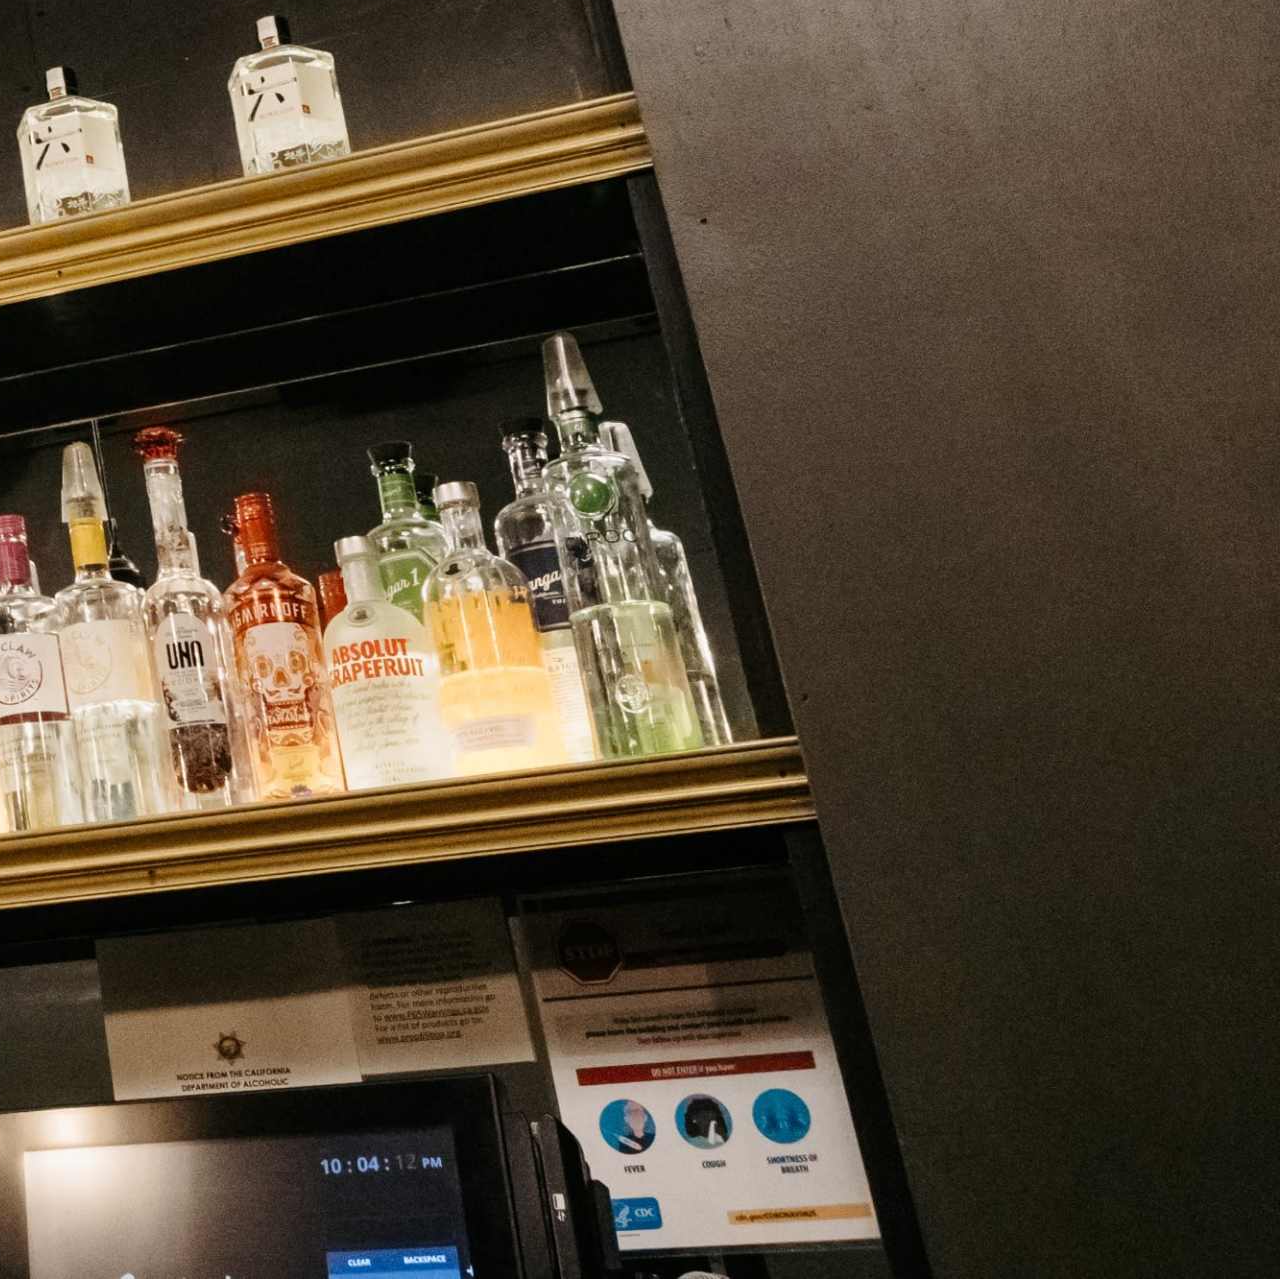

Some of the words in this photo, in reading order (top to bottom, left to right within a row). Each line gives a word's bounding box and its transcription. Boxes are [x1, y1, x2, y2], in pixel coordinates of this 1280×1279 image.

[585, 528, 638, 544] ROC
[387, 577, 411, 605] gar
[235, 601, 307, 626] SMIRNOFF
[1, 641, 37, 659] CLAW
[332, 638, 408, 666] ABSOLUT
[176, 1072, 204, 1082] NOTICE
[206, 1071, 229, 1080] FROM
[229, 1070, 242, 1079] THE
[244, 1067, 291, 1077] CALIFORNIA
[662, 1067, 675, 1076] NOT
[676, 1065, 697, 1076] ENTER
[705, 1065, 716, 1074] you
[181, 1081, 229, 1092] DEPARTMENT
[230, 1080, 241, 1089] OF
[242, 1078, 289, 1089] ALCOHOLIC
[421, 1156, 443, 1169] PM
[702, 1160, 726, 1169] COUGH
[766, 1154, 808, 1165] SHORTNESS
[624, 1164, 645, 1174] FEVER
[634, 1207, 654, 1217] CDC
[347, 1258, 371, 1267] CLEAR
[403, 1254, 447, 1265] BACKSPACE
